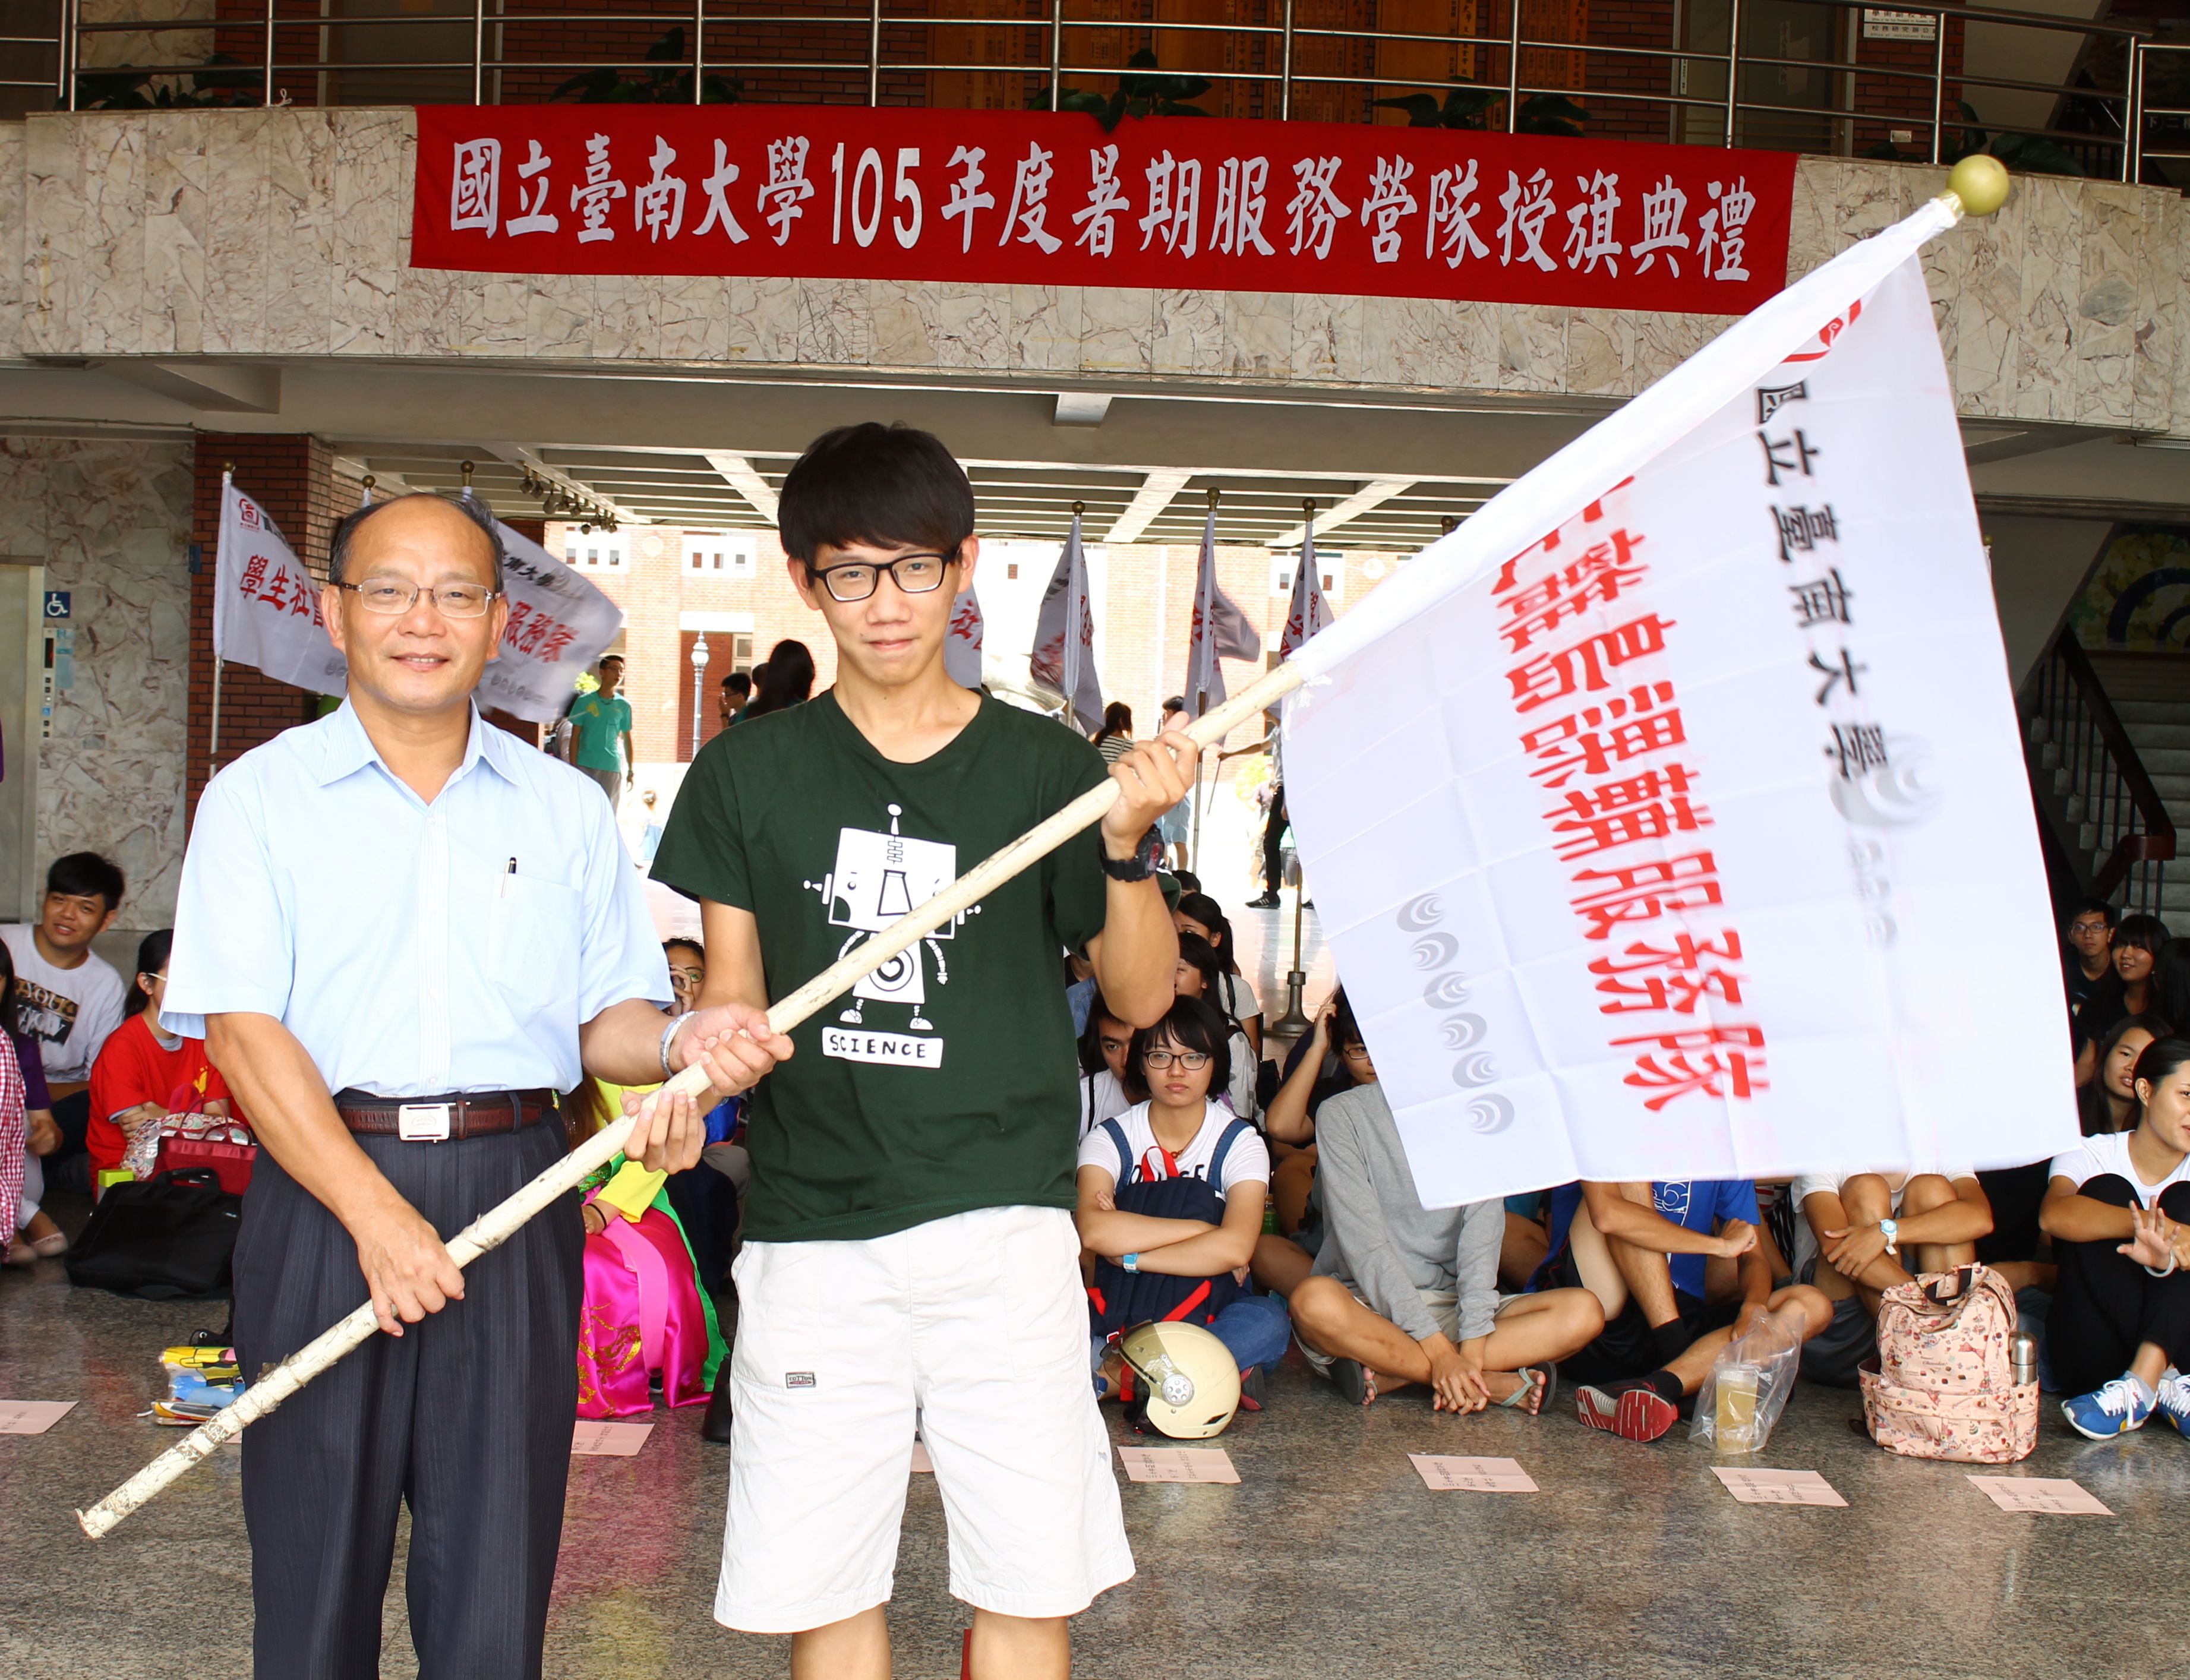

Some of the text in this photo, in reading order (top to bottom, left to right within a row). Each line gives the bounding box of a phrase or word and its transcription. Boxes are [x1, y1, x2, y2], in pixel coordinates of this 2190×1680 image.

[503, 592, 579, 662] 服務隊
[27, 983, 66, 1010] YOU
[829, 1034, 927, 1058] SCIENCE
